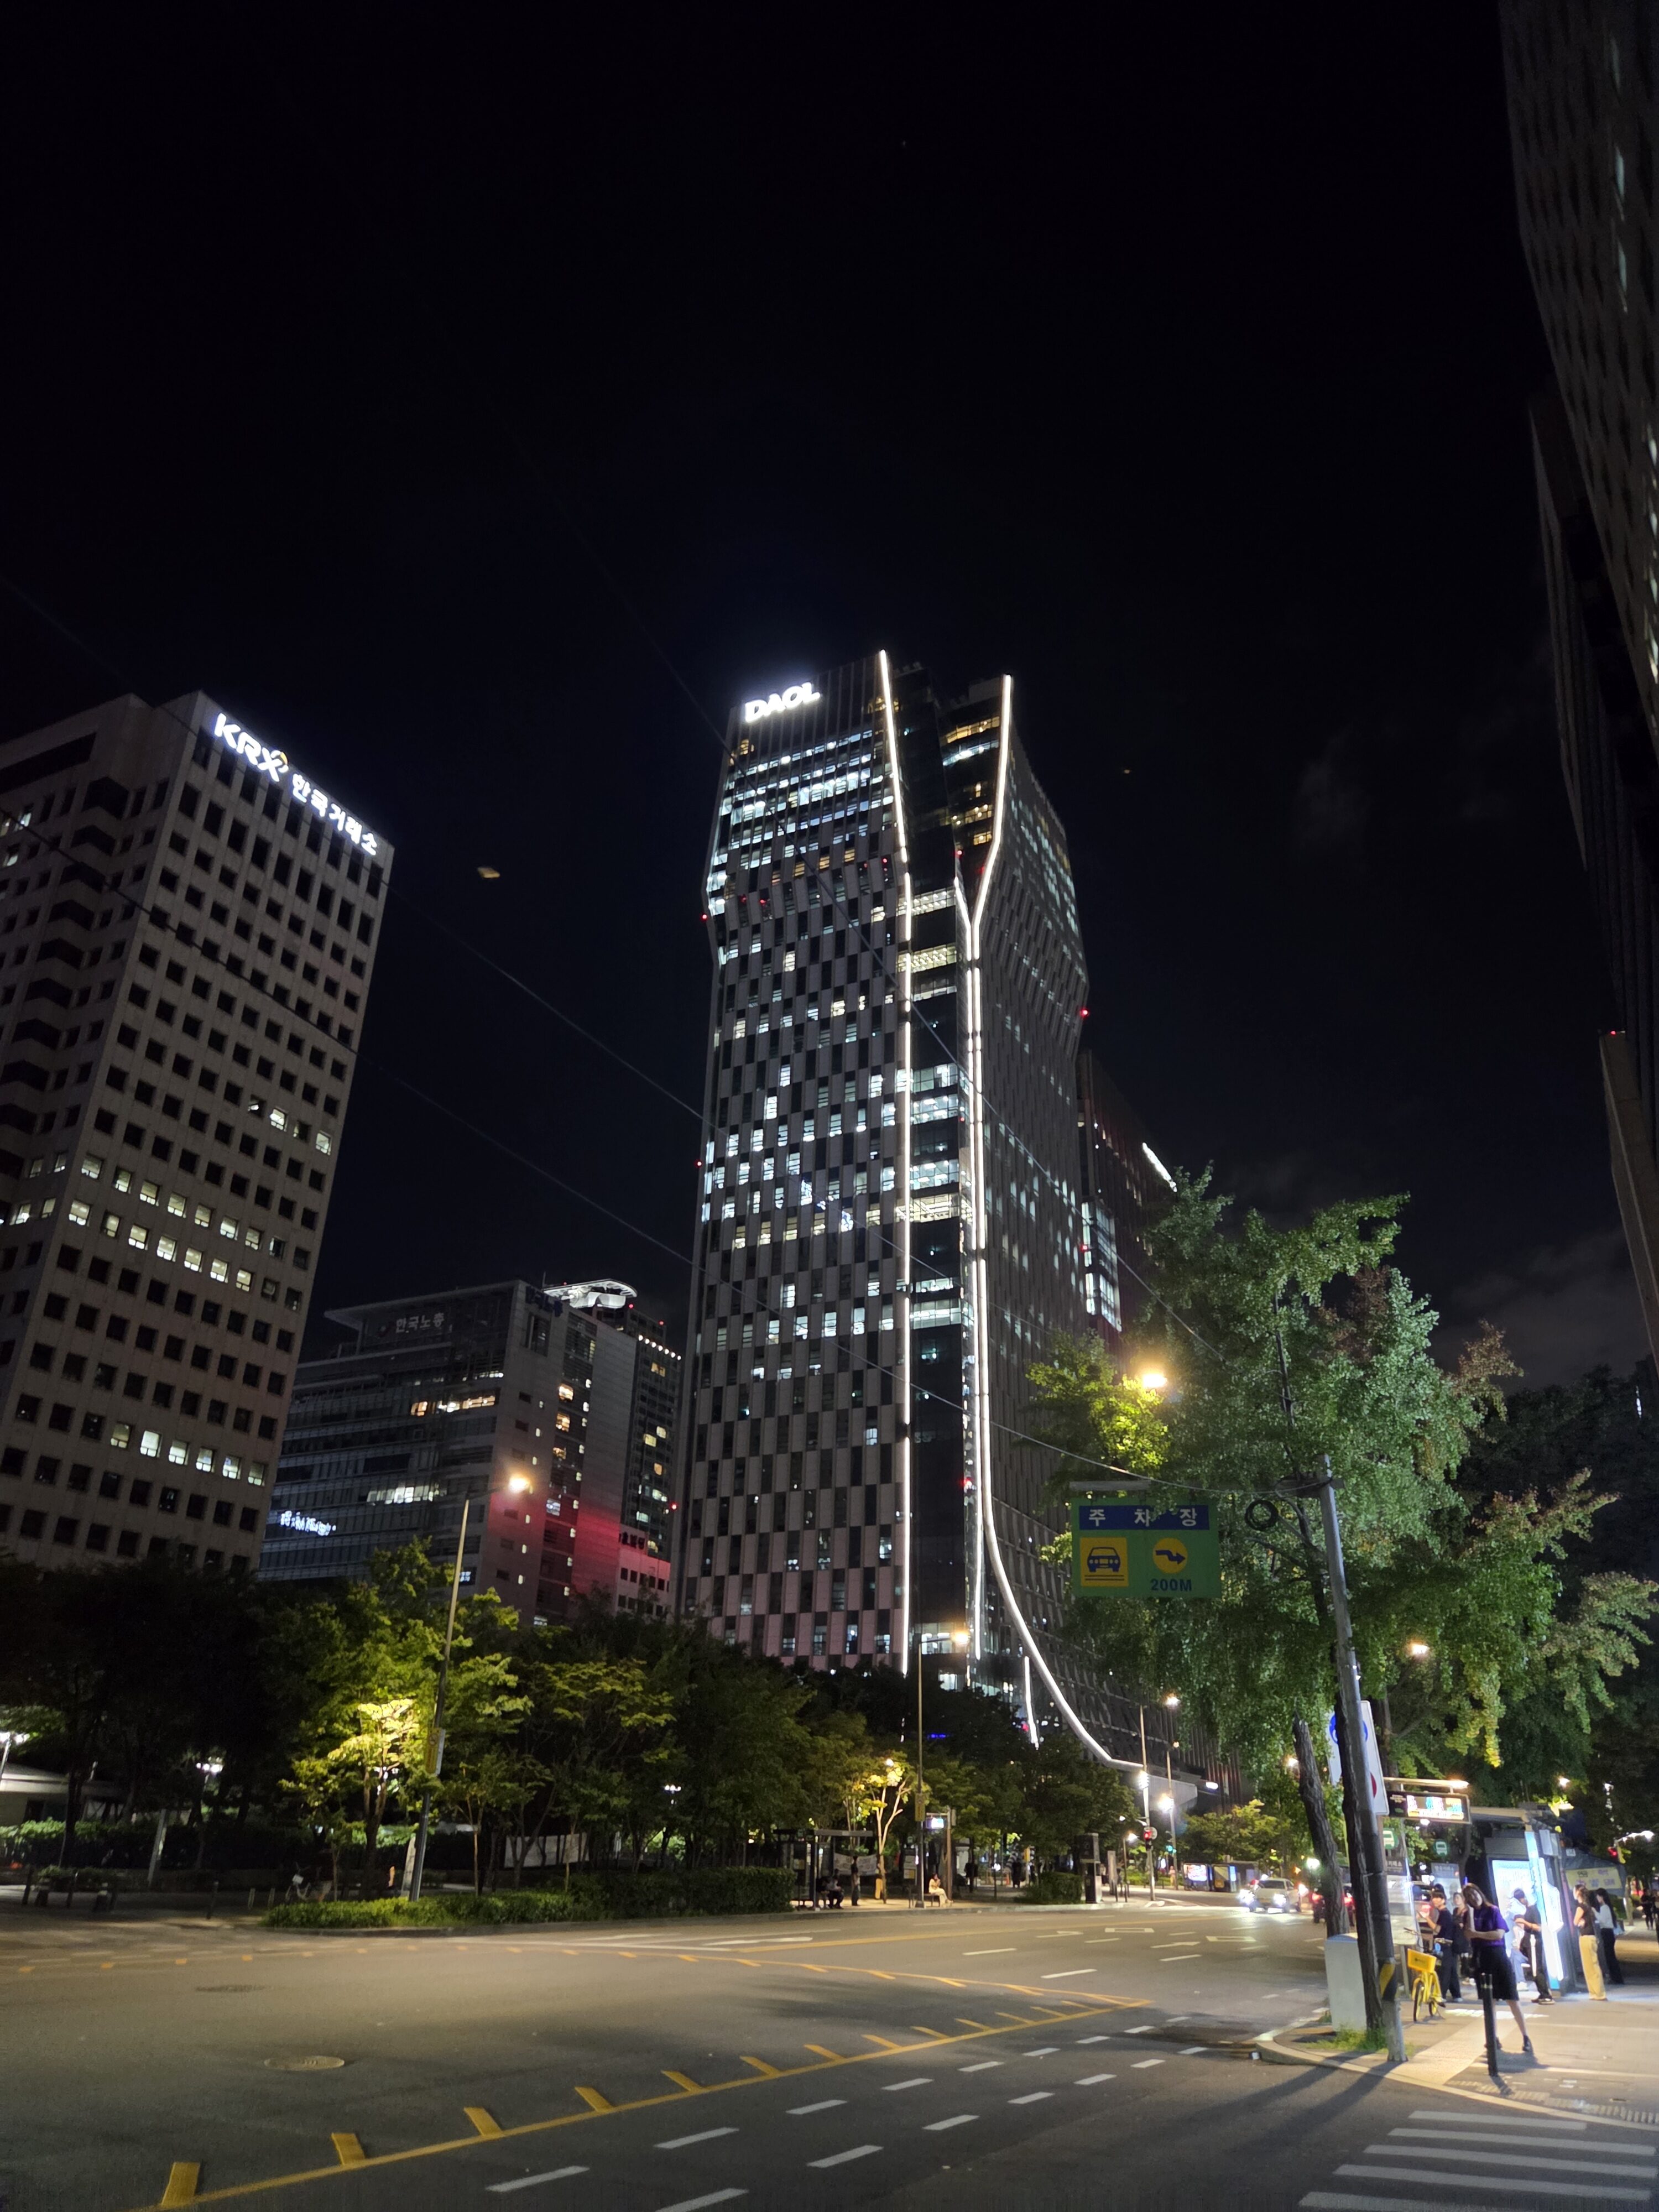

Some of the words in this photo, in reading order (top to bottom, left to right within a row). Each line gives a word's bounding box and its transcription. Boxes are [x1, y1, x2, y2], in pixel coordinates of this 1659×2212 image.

[745, 682, 821, 723] DAOL
[215, 713, 288, 782] KRX
[292, 774, 377, 855] 한국거래소
[396, 1312, 445, 1333] 한국노총
[1088, 1507, 1198, 1527] 주차장
[1151, 1578, 1192, 1592] 200M
